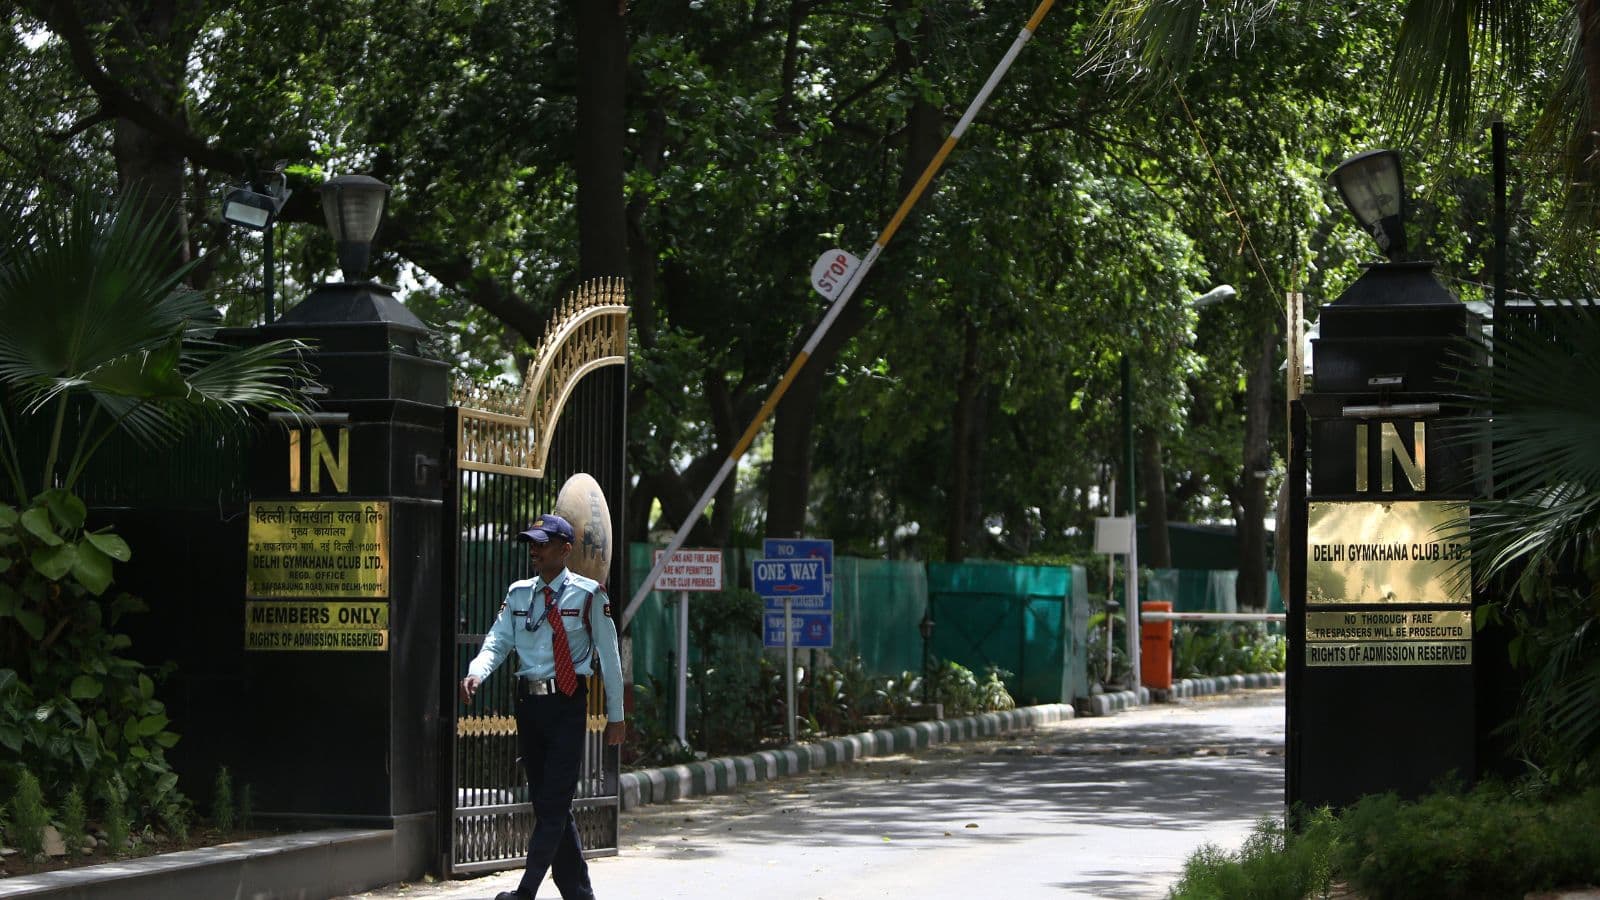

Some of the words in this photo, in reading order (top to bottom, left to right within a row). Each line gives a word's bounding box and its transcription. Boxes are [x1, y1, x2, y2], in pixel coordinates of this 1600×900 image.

[818, 254, 849, 292] STOP
[290, 428, 349, 493] IN
[1356, 421, 1426, 492] IN
[256, 506, 285, 524] दिल्ली
[288, 506, 334, 524] जिमखाना
[337, 510, 361, 524] क्लब
[290, 527, 309, 540] मुख्य
[313, 525, 346, 537] कार्यालय
[777, 544, 794, 556] NO
[1313, 544, 1345, 562] DELHI
[1348, 543, 1409, 561] GYMKHANA
[1412, 543, 1440, 561] CLUB
[253, 556, 280, 569] DELHI
[283, 556, 334, 569] GYMKHANA
[337, 556, 361, 569] CLUB
[364, 556, 383, 569] LTD.
[682, 553, 693, 563] AND
[315, 571, 345, 580] OFFICE
[664, 565, 674, 575] ARE
[675, 565, 686, 575] NOT
[686, 565, 713, 575] PERMITTED
[758, 563, 787, 581] ONE
[790, 563, 818, 580] WAY
[660, 577, 666, 587] IN
[667, 577, 677, 587] THE
[678, 577, 690, 587] CLUB
[692, 577, 716, 588] PREMISES
[252, 607, 330, 624] MEMBERS
[338, 607, 381, 624] ONLY
[1344, 614, 1357, 625] NO
[1361, 614, 1407, 625] THOROUGH
[1412, 613, 1433, 624] FARE
[768, 617, 805, 629] SPED
[771, 631, 802, 643] LIIT
[1315, 628, 1372, 638] TRESPASSERS
[1374, 628, 1394, 637] WILL
[1396, 627, 1407, 637] BE
[1409, 626, 1463, 637] PROSECUTED
[250, 633, 280, 647] RIGHTS
[282, 633, 292, 647] OF
[294, 633, 339, 647] ADMISSION
[341, 633, 384, 647] RESERVED
[1311, 647, 1346, 662] RIGHTS
[1350, 647, 1361, 662] OF
[1362, 646, 1415, 661] ADMISSION
[1417, 646, 1467, 661] RESERVED
